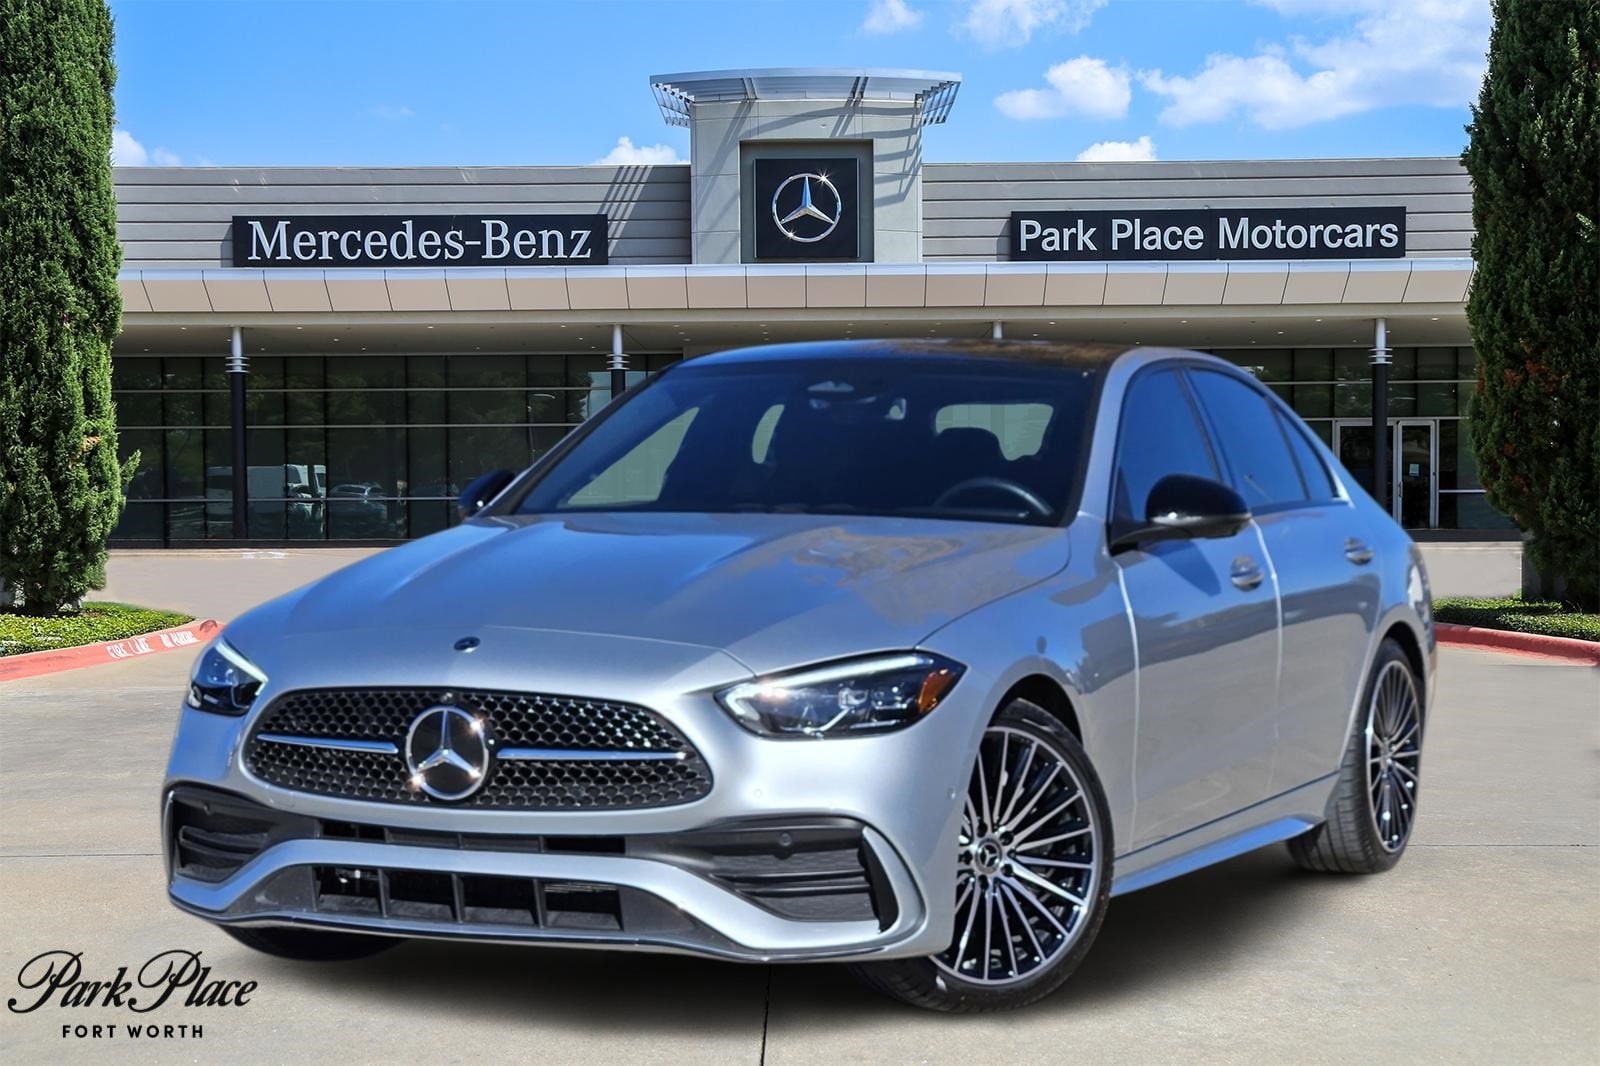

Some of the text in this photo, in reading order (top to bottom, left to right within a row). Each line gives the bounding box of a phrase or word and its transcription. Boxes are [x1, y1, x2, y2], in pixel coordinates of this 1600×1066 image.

[247, 219, 592, 261] Mercedes-Benz
[1019, 217, 1400, 252] Park Place Motorcars
